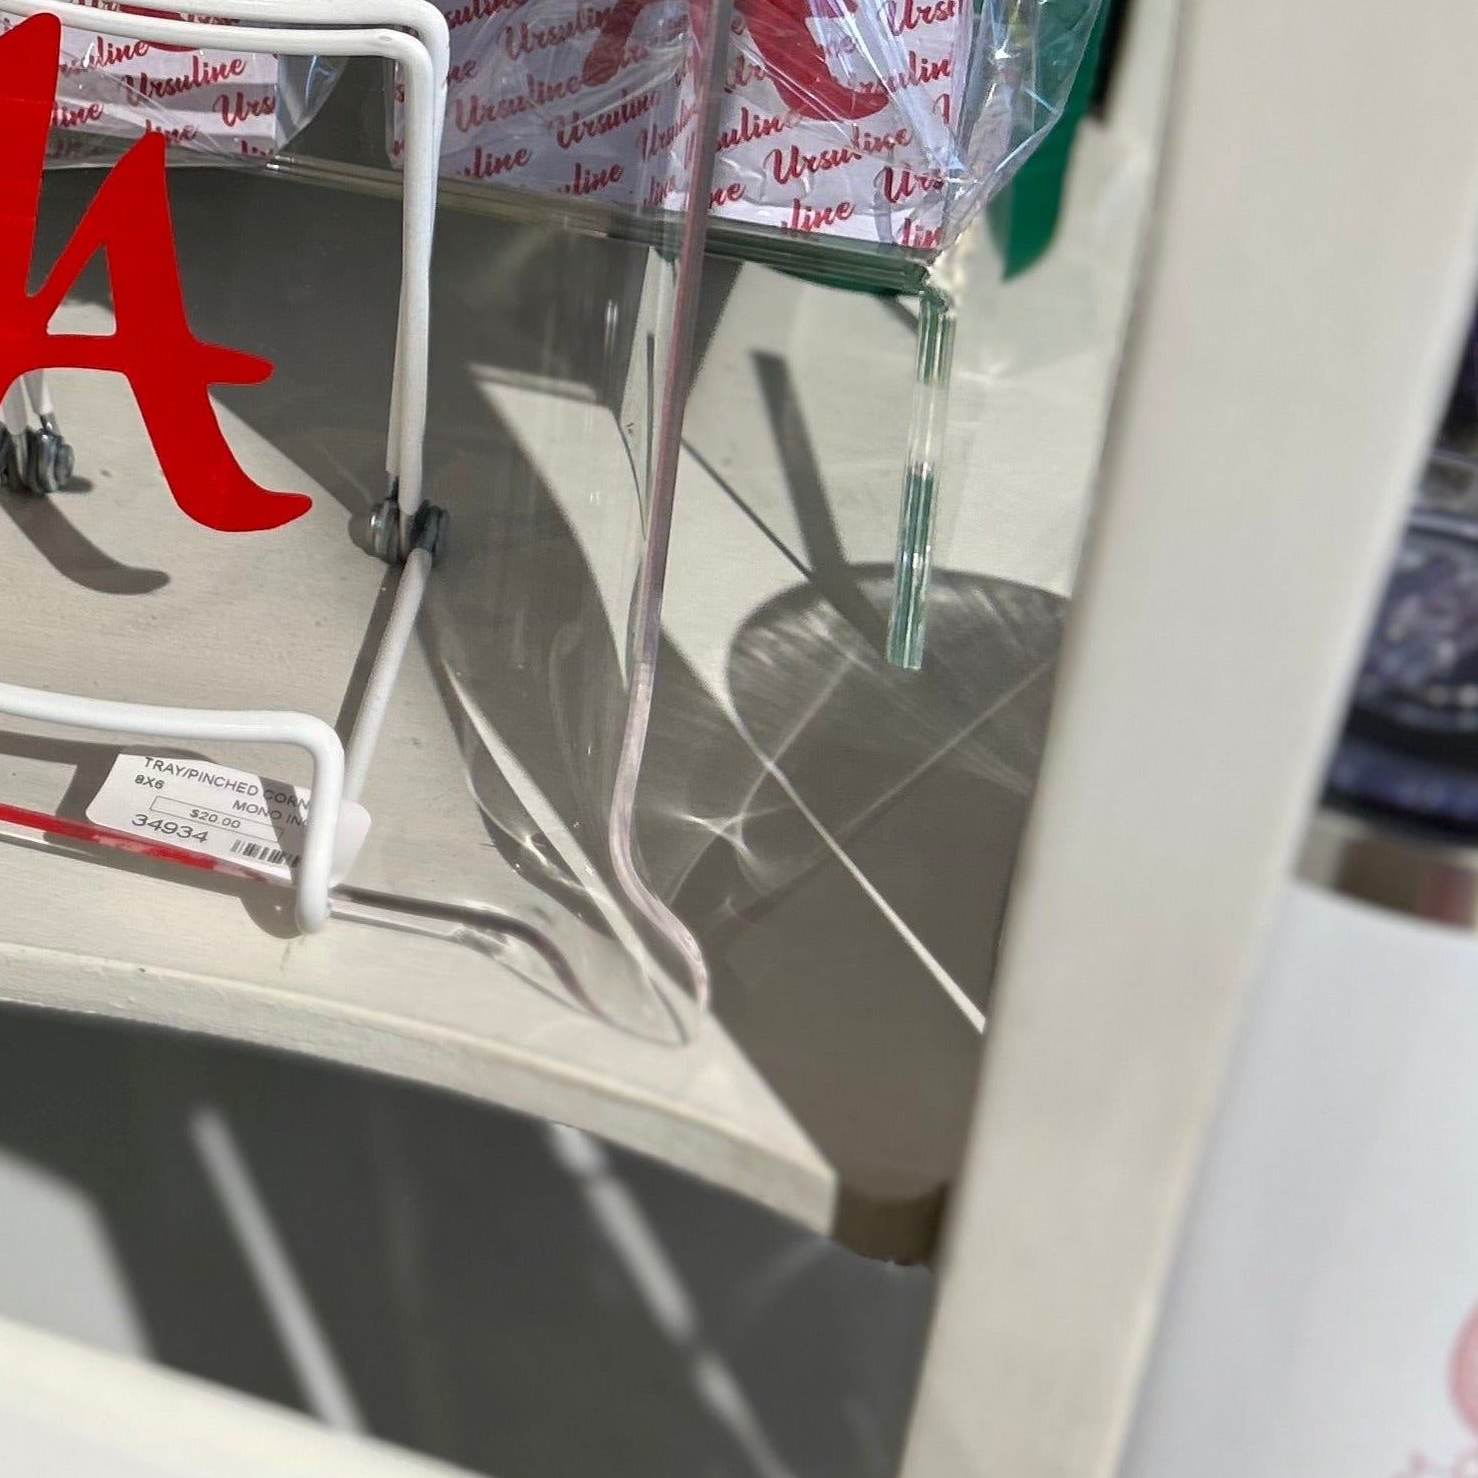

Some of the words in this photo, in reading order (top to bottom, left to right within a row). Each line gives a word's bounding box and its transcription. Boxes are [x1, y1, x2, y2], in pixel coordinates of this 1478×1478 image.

[123, 54, 247, 107] Ursuline
[134, 774, 165, 790] 8X6
[144, 757, 259, 796] TRAY/PINCHED
[189, 808, 241, 829] $20.00
[232, 800, 282, 820] MONO
[131, 813, 209, 843] 34934
